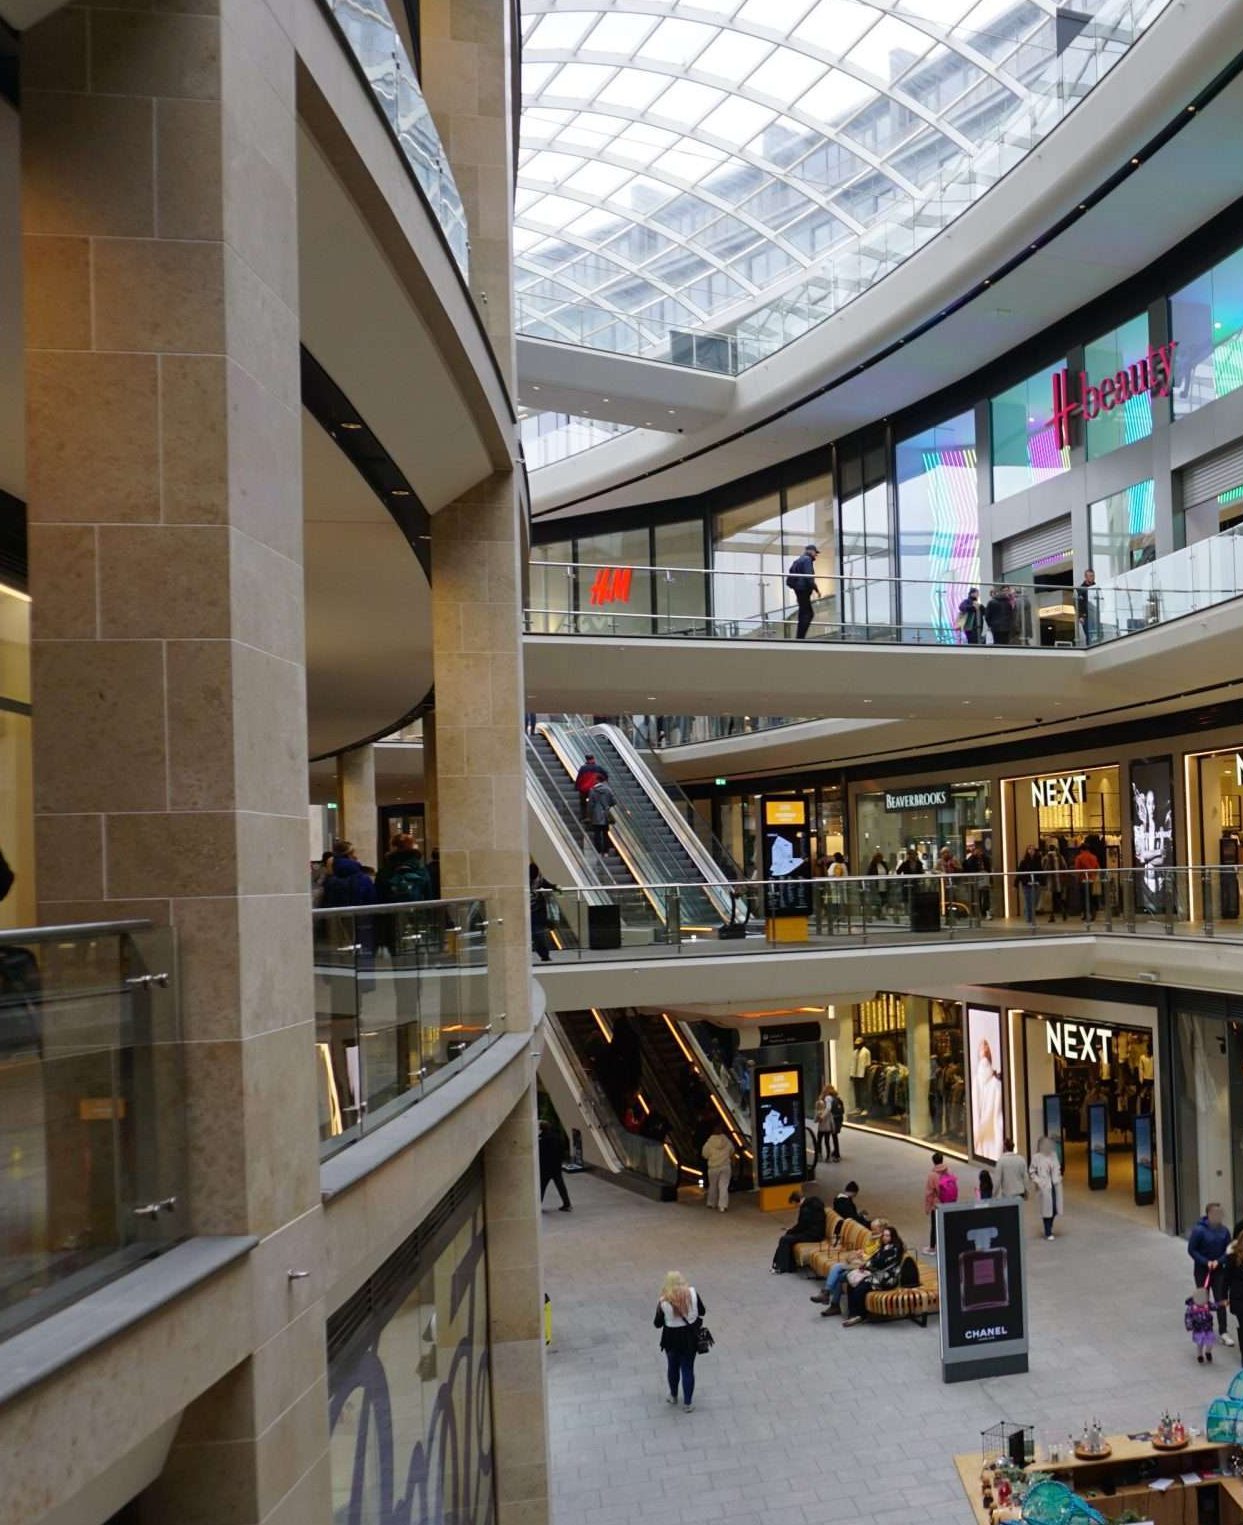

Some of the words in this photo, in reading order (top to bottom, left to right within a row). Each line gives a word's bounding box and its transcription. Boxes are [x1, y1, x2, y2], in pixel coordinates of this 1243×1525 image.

[1079, 340, 1179, 420] beauty
[1031, 775, 1087, 808] NEXT
[1046, 1020, 1113, 1065] NEXT
[964, 1326, 1008, 1340] CHANEL
